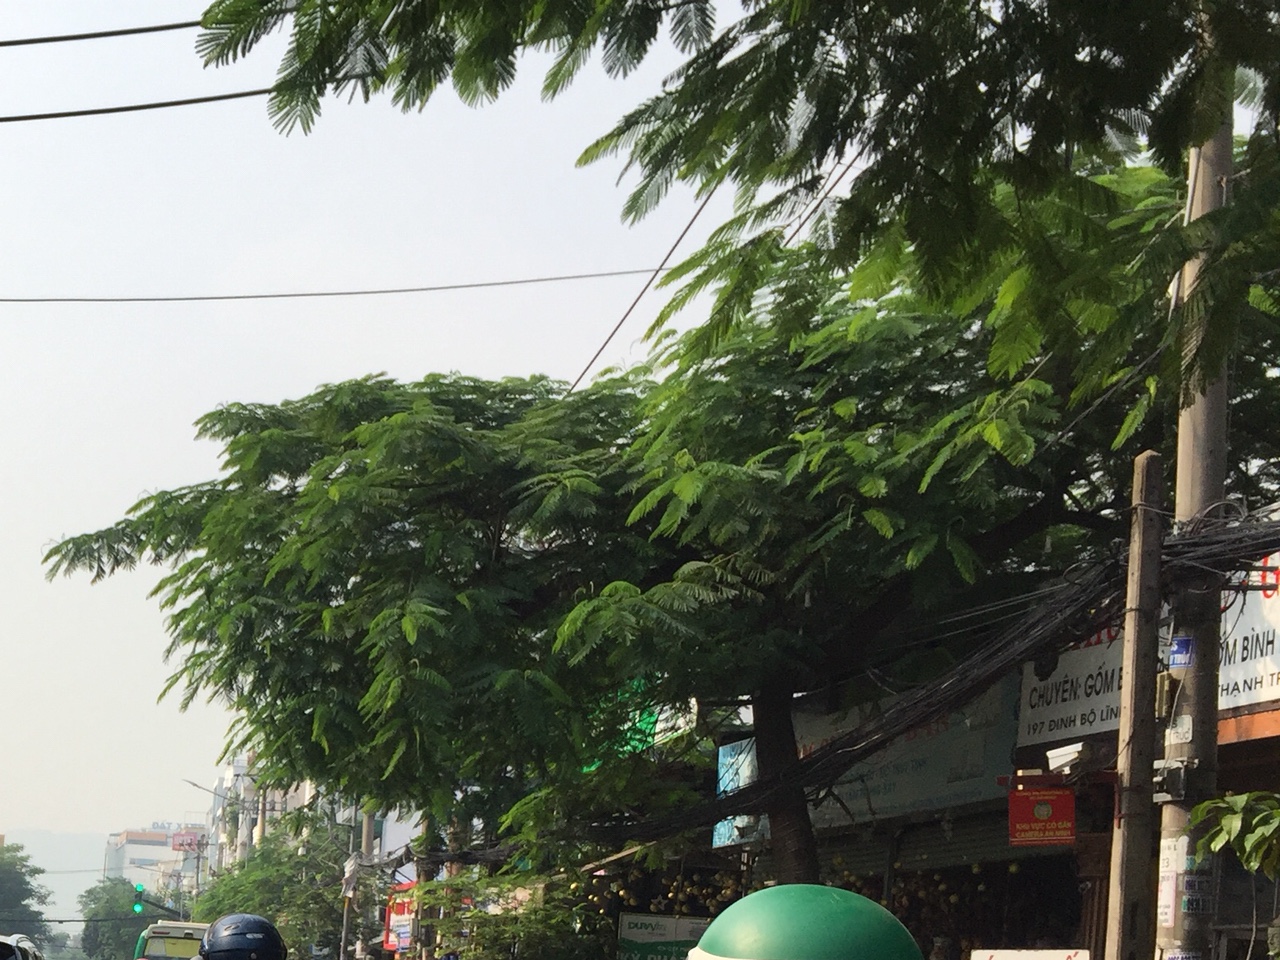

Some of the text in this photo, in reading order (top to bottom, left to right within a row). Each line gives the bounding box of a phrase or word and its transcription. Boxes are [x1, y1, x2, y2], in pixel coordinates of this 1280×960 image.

[1241, 627, 1276, 662] BÌNH
[1084, 662, 1115, 698] GỐM
[1219, 675, 1263, 697] HẠNH
[1027, 705, 1121, 736] 197 ĐINH BỘ LĨN
